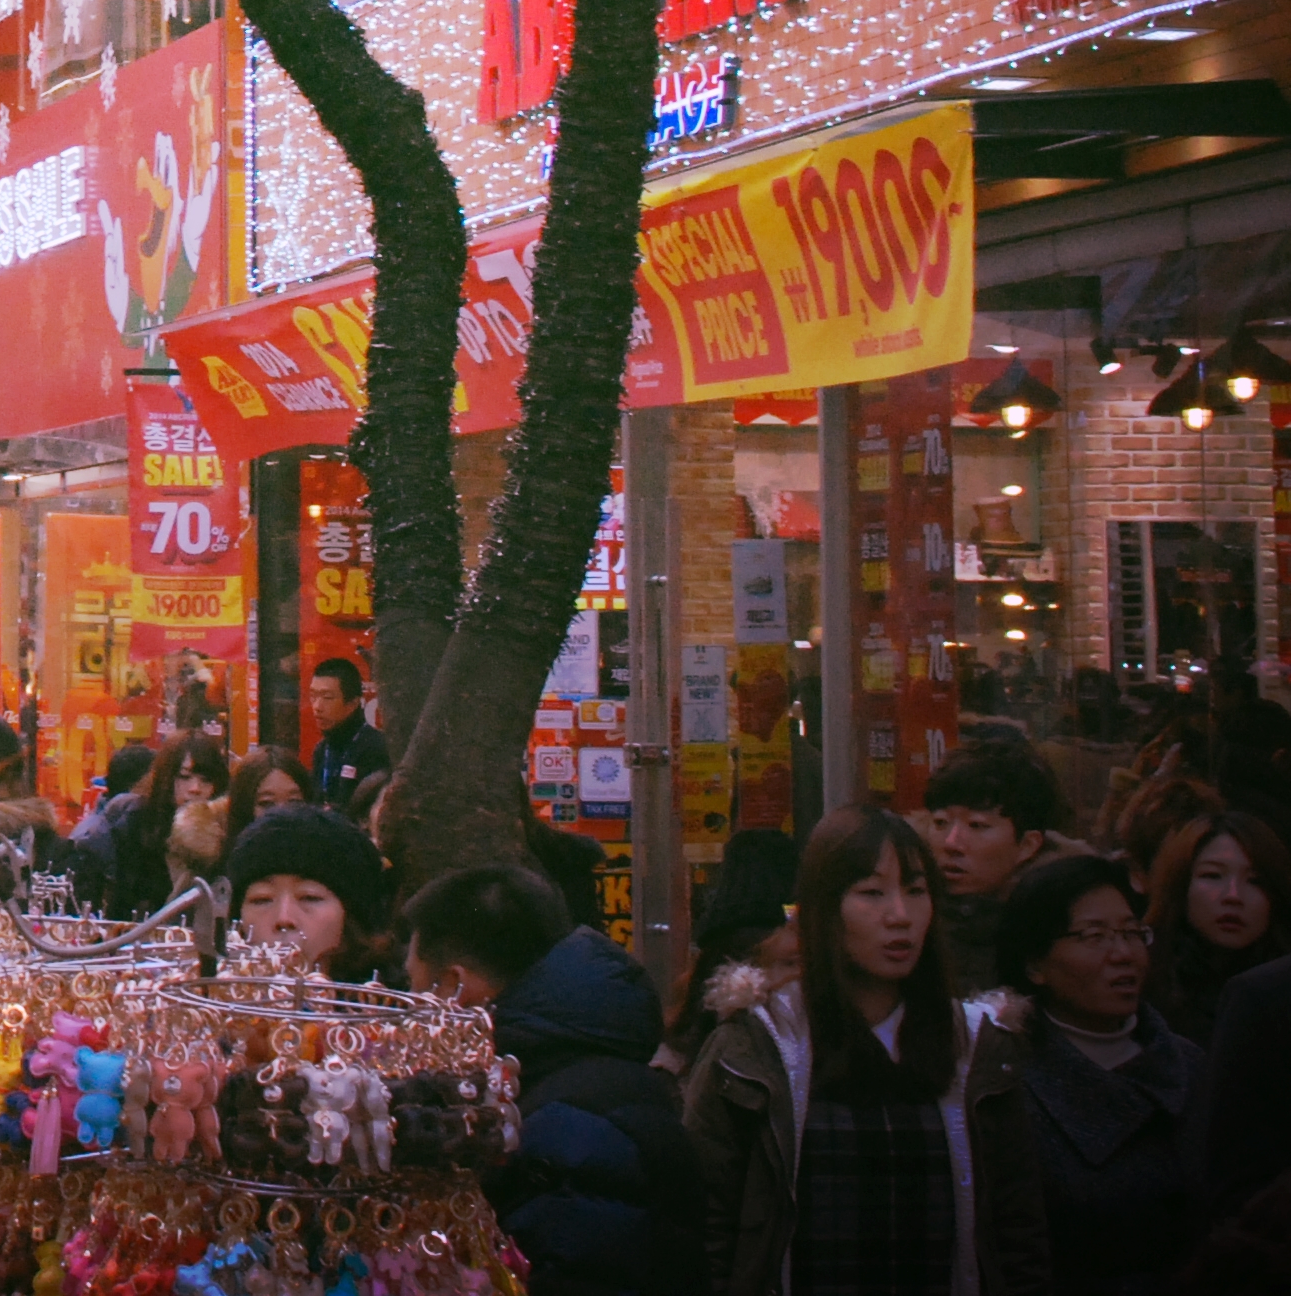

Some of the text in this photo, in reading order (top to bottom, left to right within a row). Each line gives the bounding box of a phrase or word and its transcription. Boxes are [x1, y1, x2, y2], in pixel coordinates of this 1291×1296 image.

[650, 206, 756, 289] SPECIAL
[693, 290, 769, 365] PRICE
[542, 755, 565, 769] OK
